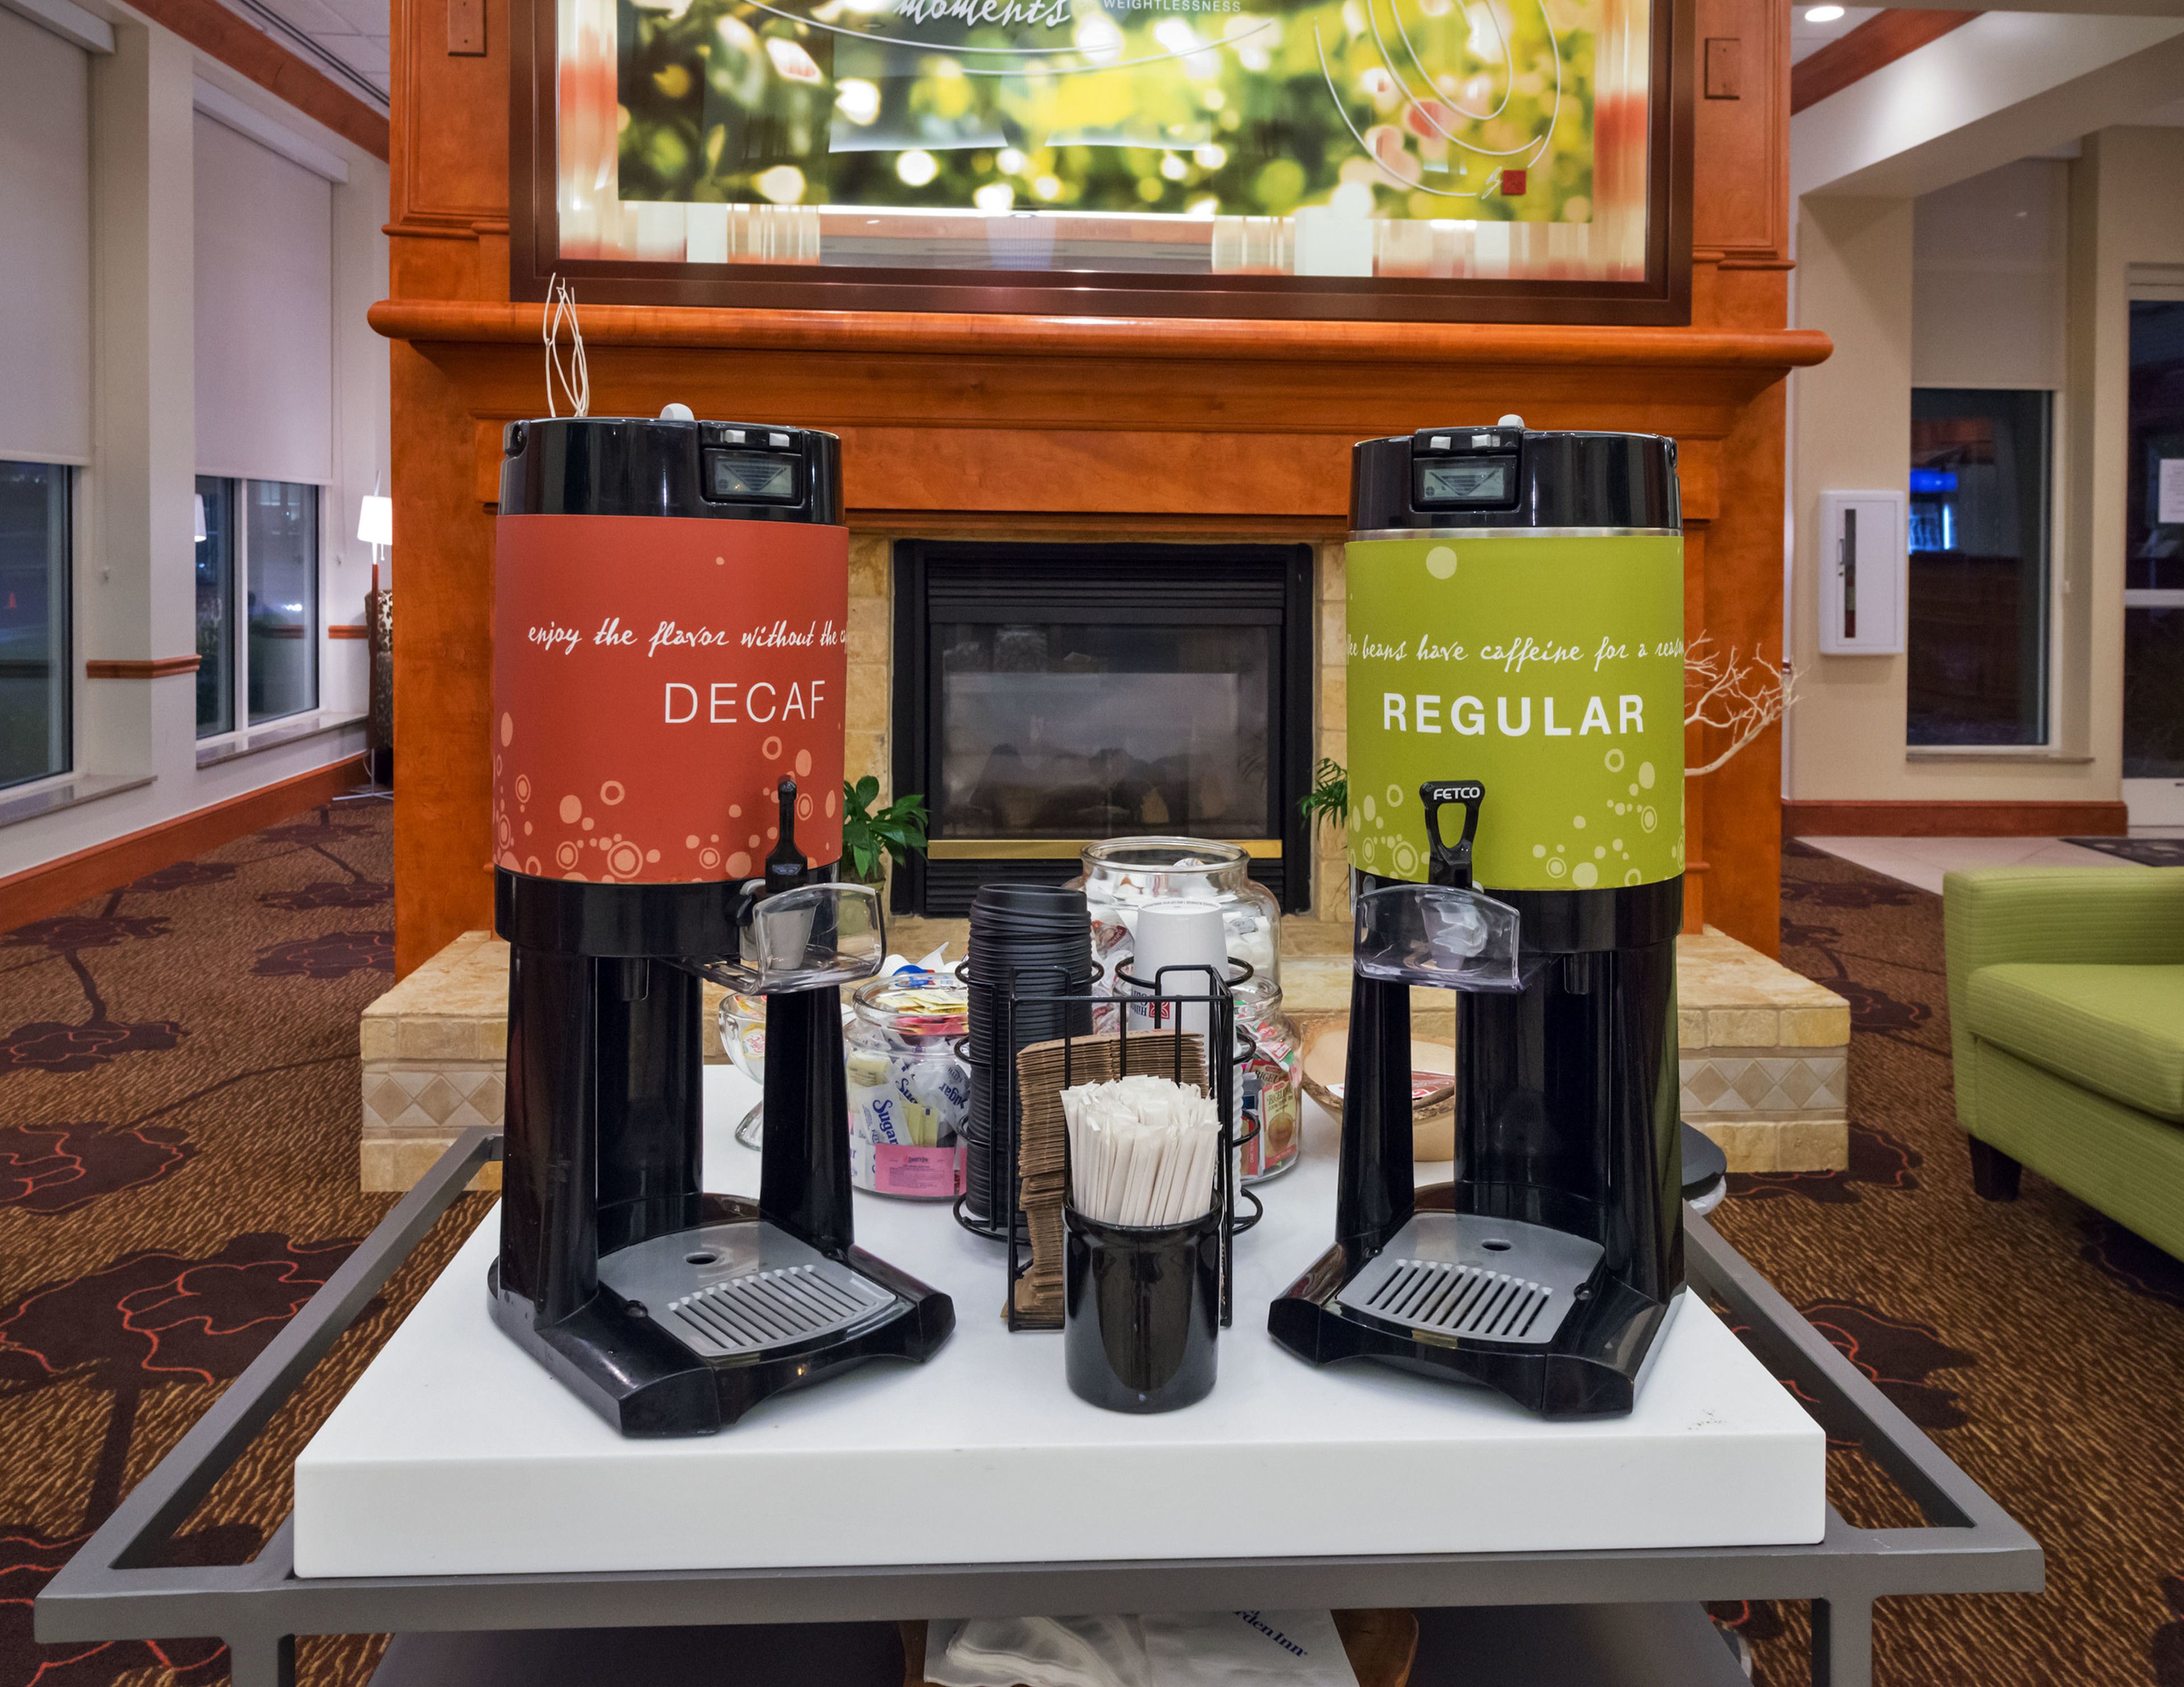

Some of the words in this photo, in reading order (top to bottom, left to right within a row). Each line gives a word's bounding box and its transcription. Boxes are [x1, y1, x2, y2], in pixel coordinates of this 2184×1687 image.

[894, 0, 1070, 27] moments
[1103, 0, 1241, 12] WEIGHTLESSNESS
[528, 621, 582, 656] enjoy
[593, 617, 638, 646] the
[648, 620, 730, 658] flavor
[740, 620, 816, 648] without
[819, 620, 838, 646] the
[1362, 634, 1408, 661] beans
[1416, 633, 1469, 661] have
[1480, 637, 1584, 673] caffeine
[1594, 636, 1629, 672] for
[1638, 643, 1648, 658] a
[665, 680, 825, 723] DECAF
[1384, 693, 1644, 737] REGULAR
[1433, 786, 1480, 801] FETCO
[872, 1100, 899, 1145] Sugar
